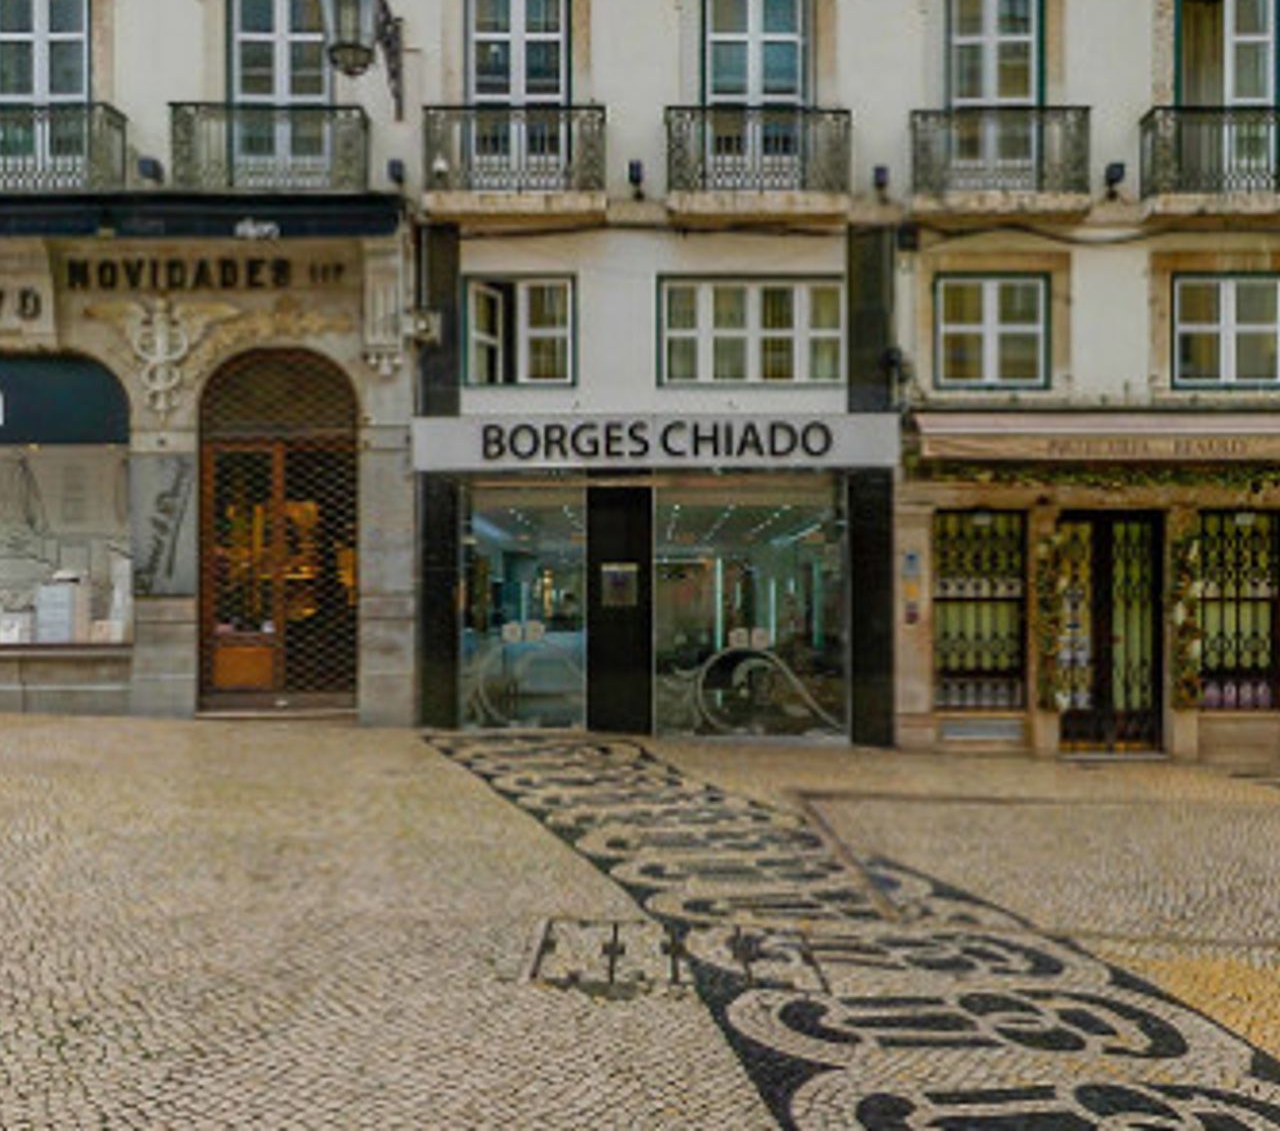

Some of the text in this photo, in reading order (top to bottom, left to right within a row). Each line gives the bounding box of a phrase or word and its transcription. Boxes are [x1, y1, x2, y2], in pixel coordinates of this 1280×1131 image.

[67, 258, 292, 289] NOVIDADES
[481, 421, 832, 459] BORGES CHIADO
